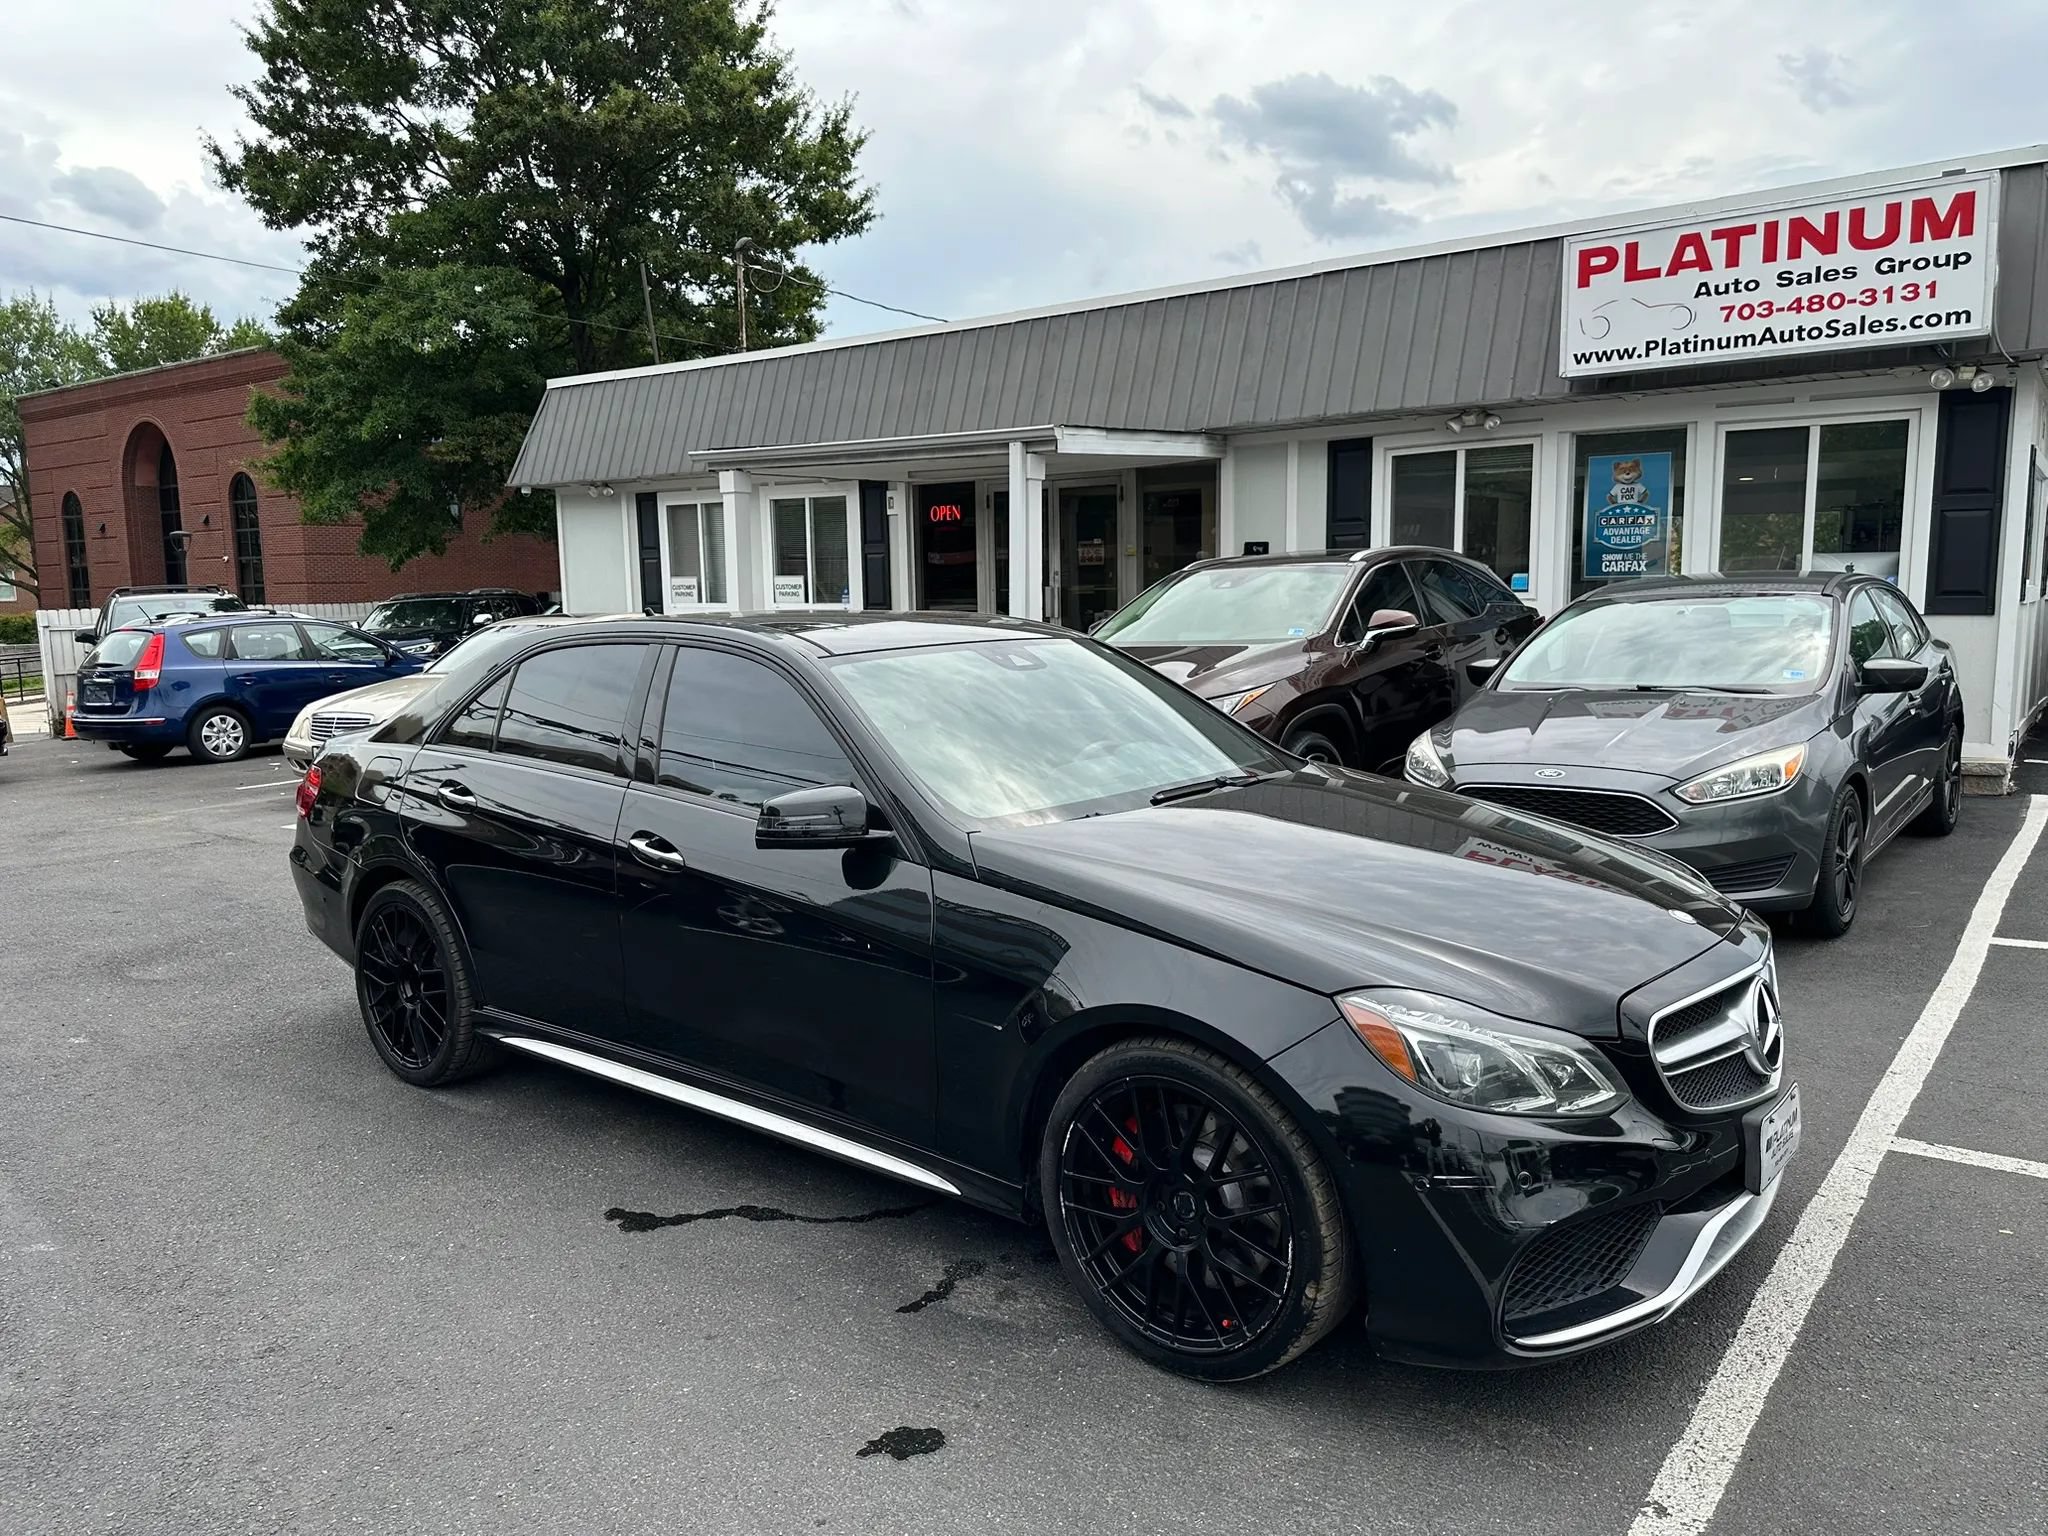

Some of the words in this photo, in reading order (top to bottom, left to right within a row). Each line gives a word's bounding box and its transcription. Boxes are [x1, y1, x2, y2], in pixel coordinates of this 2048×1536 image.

[1577, 190, 1977, 290] PLATINUM
[1693, 277, 1760, 300] Auto
[1775, 264, 1858, 288] Sales
[1874, 250, 1973, 277] Group
[1719, 280, 1938, 323] 703-480-3131
[1573, 308, 1972, 366] www.PlatinumAutoSales.com
[1620, 486, 1635, 494] CAR
[930, 505, 961, 522] OPEN
[1600, 515, 1655, 526] CARFAX
[1602, 527, 1650, 535] ADVANTAGE
[1610, 536, 1642, 544] DEALER
[1601, 553, 1623, 561] SHOW
[1601, 561, 1647, 573] CARFAX
